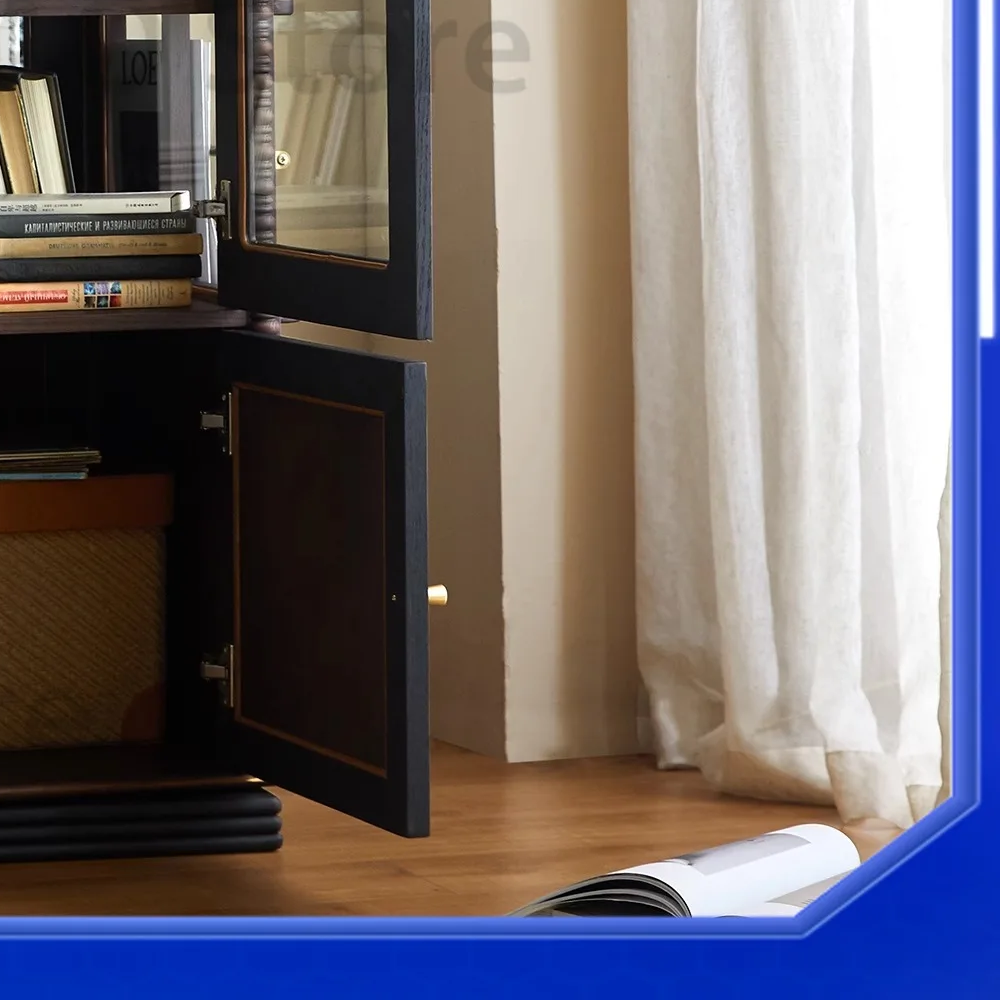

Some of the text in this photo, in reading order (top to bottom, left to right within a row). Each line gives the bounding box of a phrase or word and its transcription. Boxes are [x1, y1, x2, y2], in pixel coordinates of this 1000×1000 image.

[24, 219, 187, 234] КАПИТАЛИСТИЧЕСКИЕ И РАЗВИВАЮЩИЕСЯ СТРАНЫ
